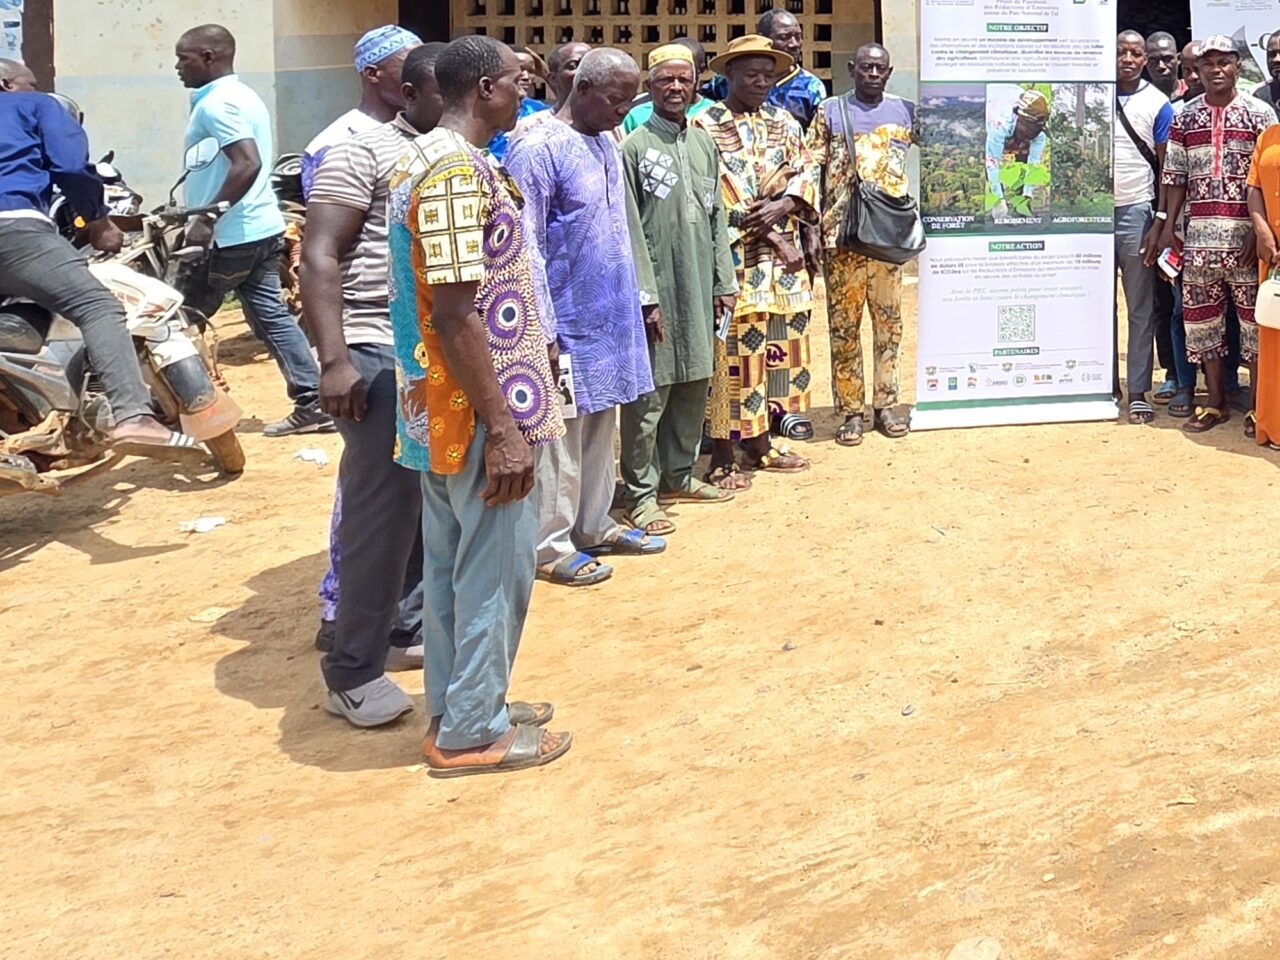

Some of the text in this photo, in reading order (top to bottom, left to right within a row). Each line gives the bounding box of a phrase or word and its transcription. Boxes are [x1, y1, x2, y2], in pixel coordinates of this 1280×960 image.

[1013, 24, 1047, 32] OBJECTIF
[923, 215, 975, 223] CONSERVATION
[1015, 242, 1043, 250] ACTION
